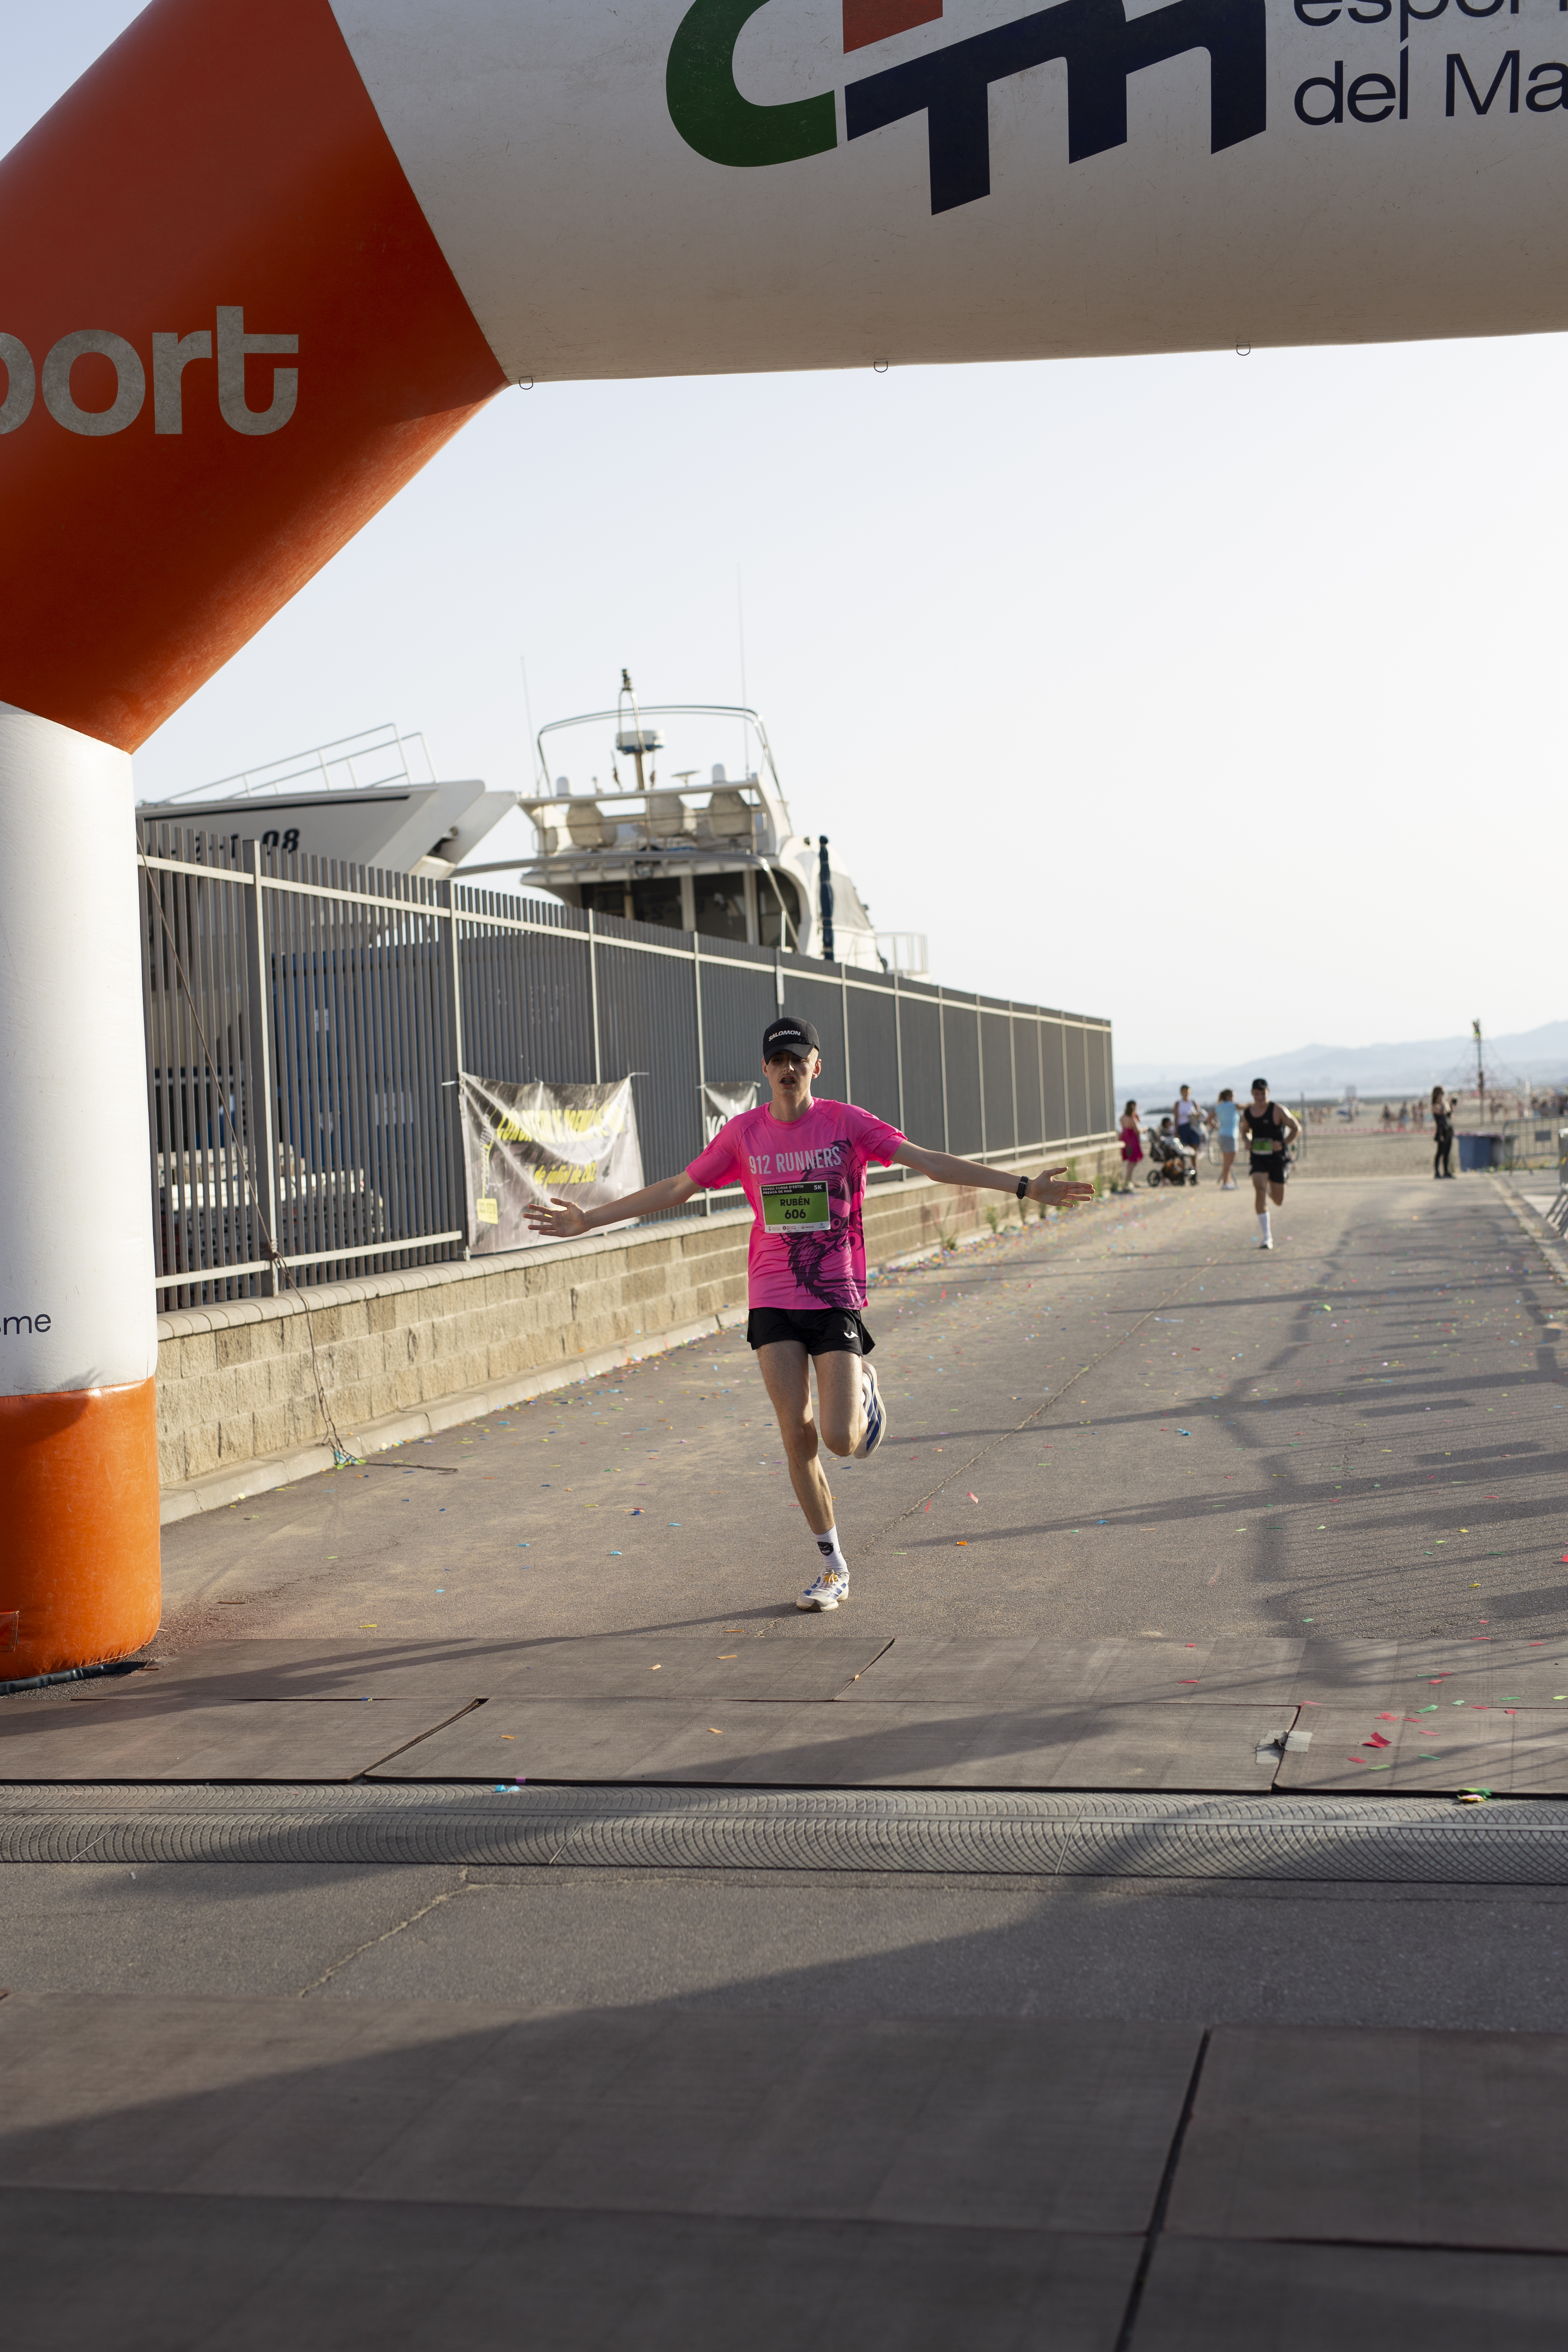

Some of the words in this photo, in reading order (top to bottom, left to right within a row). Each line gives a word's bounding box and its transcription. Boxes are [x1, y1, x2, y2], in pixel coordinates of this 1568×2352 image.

[1294, 44, 1409, 126] del
[769, 1030, 801, 1041] SALOMON
[748, 1155, 772, 1175] 912
[775, 1145, 842, 1173] RUNNERS
[780, 1195, 810, 1207] RUBÉN
[784, 1209, 806, 1219] 606
[0, 1314, 51, 1335] me
